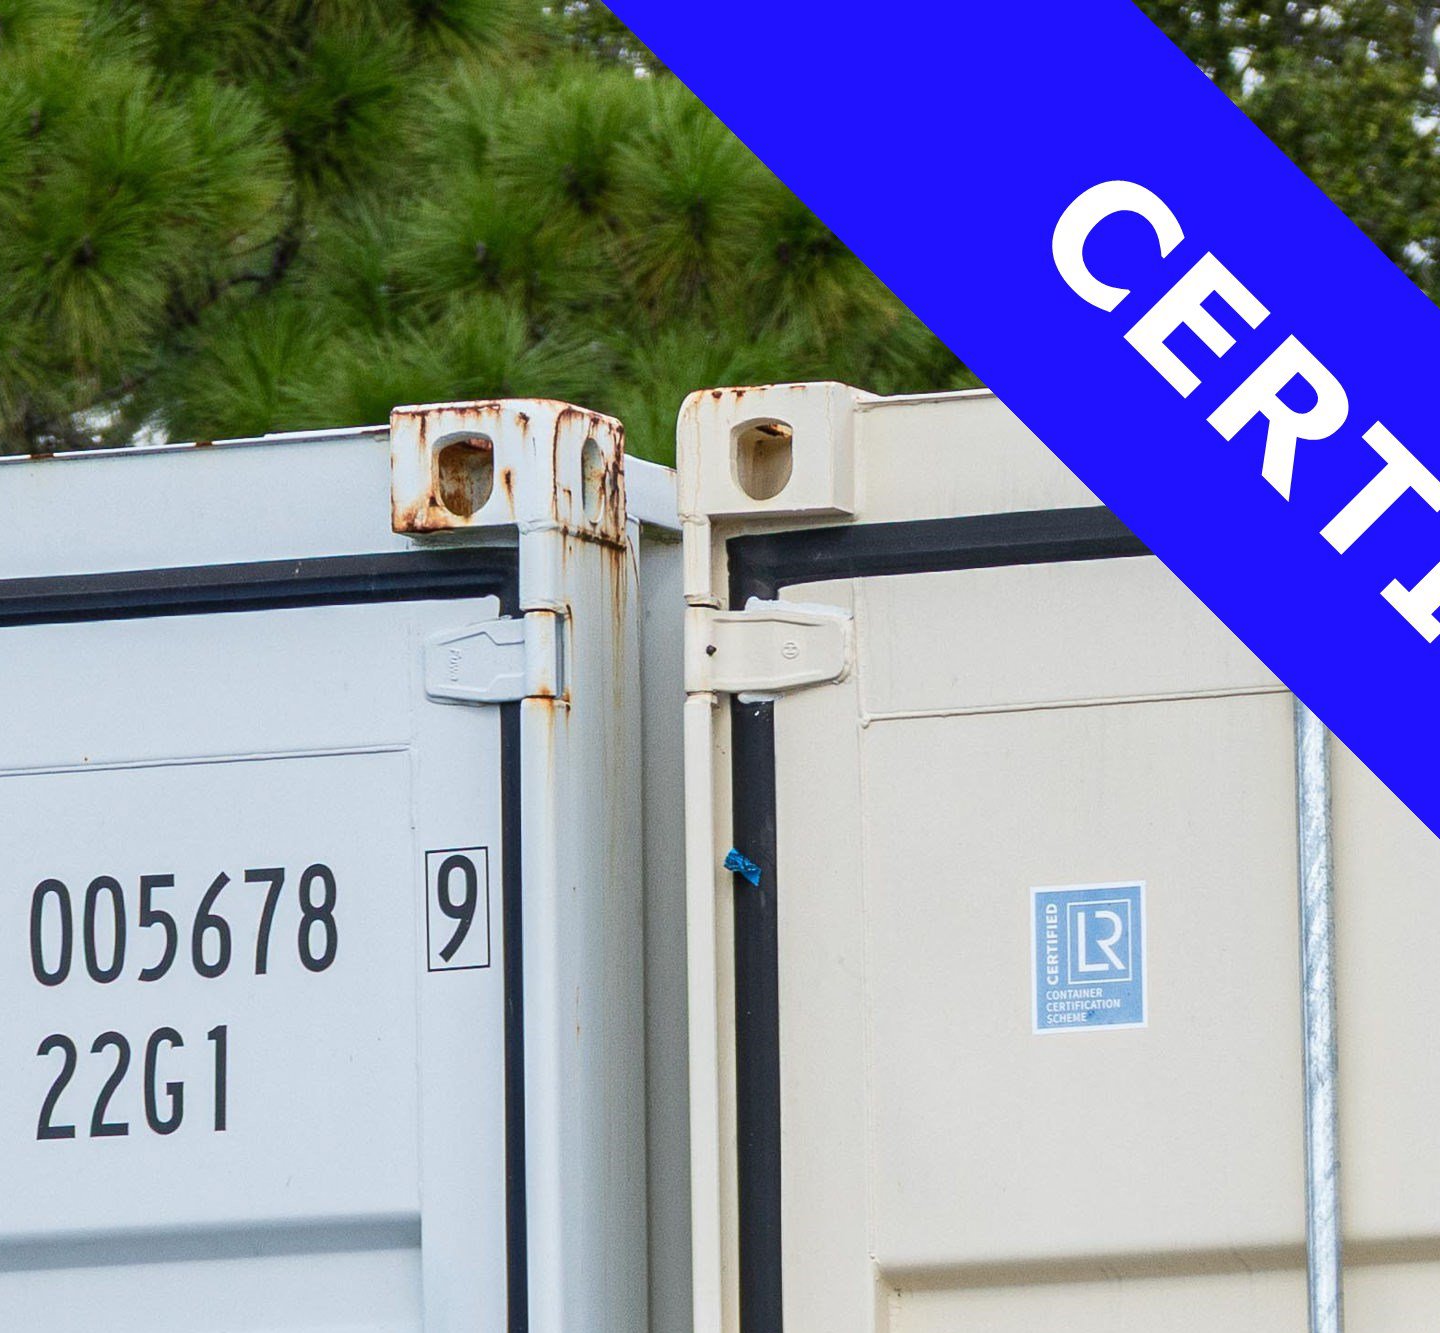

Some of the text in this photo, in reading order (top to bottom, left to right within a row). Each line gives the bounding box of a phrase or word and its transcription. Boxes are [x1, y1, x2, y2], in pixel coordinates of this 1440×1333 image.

[29, 862, 338, 988] 005678
[437, 853, 478, 963] 9
[1046, 903, 1059, 986] CERTIFIED
[1046, 987, 1103, 1000] CONTAINER
[1046, 998, 1121, 1013] CERTIFICATION
[1046, 1012, 1087, 1024] SCHEME
[35, 1024, 229, 1141] 22G1
